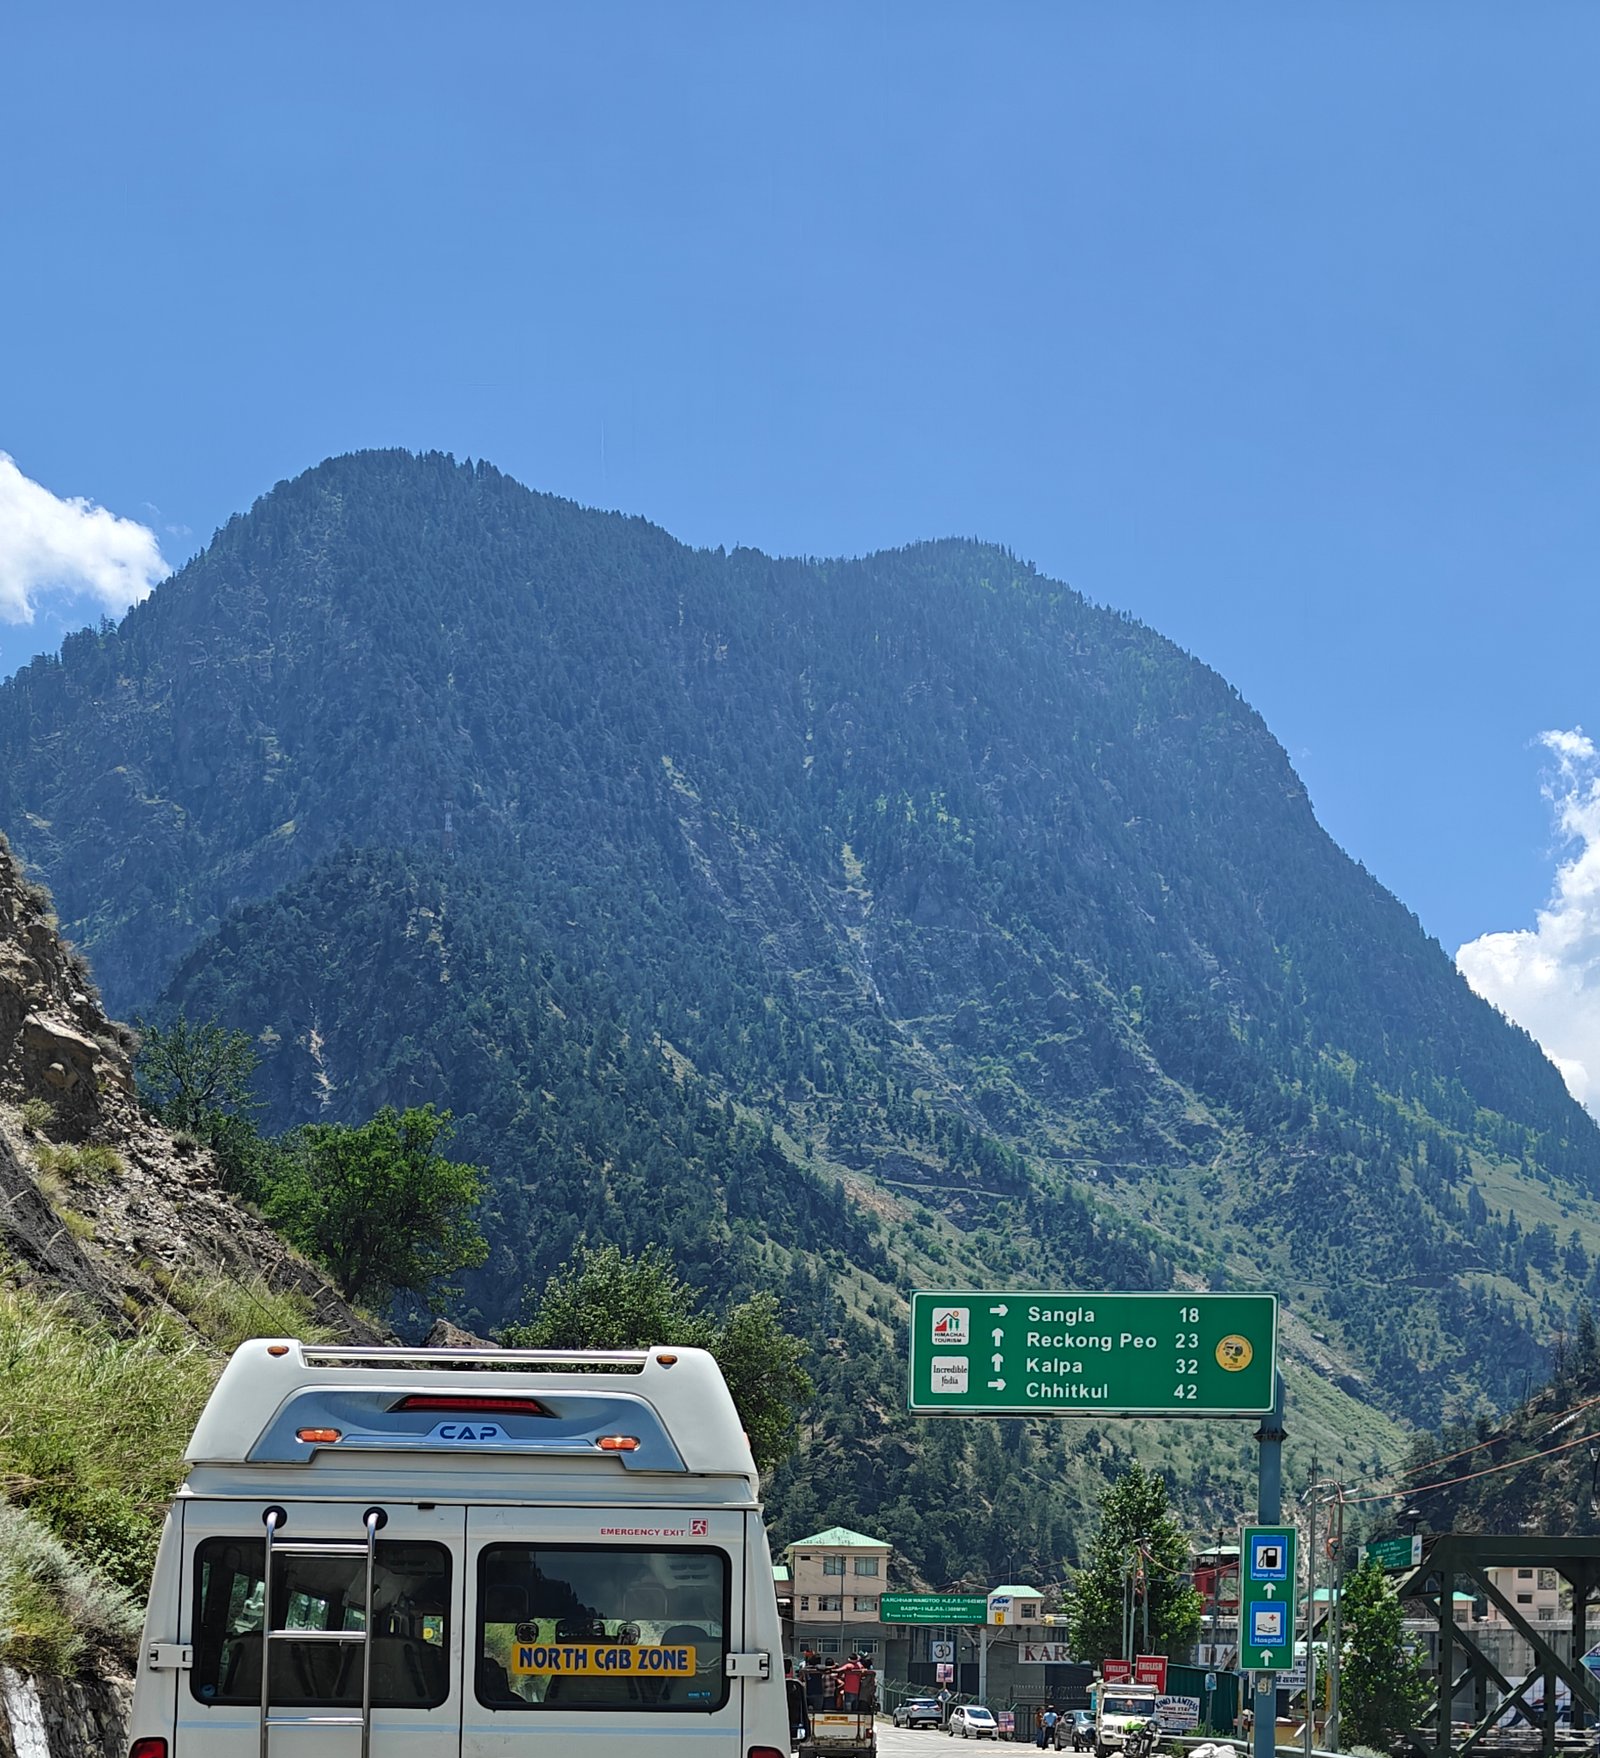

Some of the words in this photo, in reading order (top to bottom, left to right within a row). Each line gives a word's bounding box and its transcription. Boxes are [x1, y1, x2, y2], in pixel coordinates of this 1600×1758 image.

[1028, 1306, 1095, 1326] Sangla
[1179, 1307, 1200, 1323] 18
[1027, 1332, 1112, 1351] Reckong
[1120, 1333, 1157, 1348] Peo
[1175, 1333, 1199, 1349] 23
[933, 1365, 967, 1374] Incredible
[1026, 1357, 1083, 1376] Kalpa
[1175, 1359, 1198, 1374] 32
[1026, 1382, 1108, 1399] Chhitkul
[1173, 1384, 1198, 1400] 42
[440, 1425, 497, 1440] CAP
[600, 1528, 660, 1536] EMERGENCY
[663, 1529, 685, 1537] EXIT
[519, 1647, 588, 1670] NORTH
[594, 1649, 632, 1671] CAB
[638, 1649, 688, 1671] ZONE
